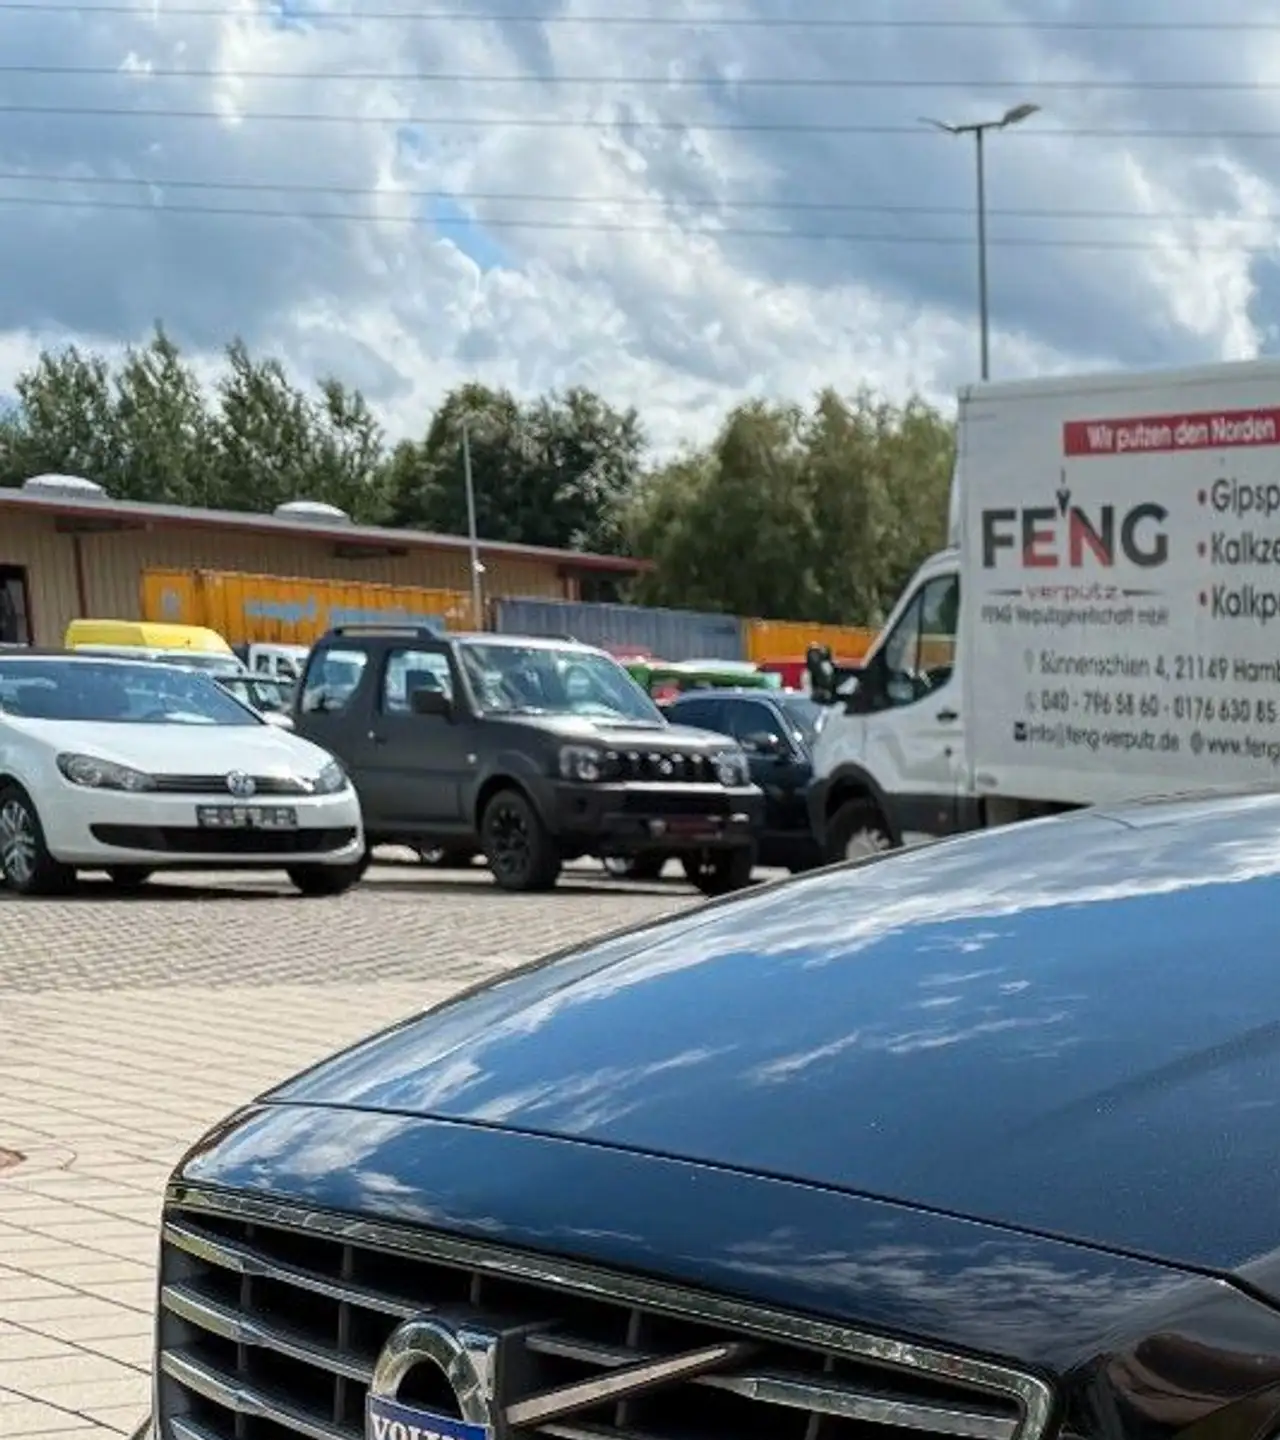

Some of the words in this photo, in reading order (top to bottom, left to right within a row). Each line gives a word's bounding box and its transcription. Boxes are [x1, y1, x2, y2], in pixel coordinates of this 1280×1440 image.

[1087, 425, 1112, 449] Wir
[1116, 422, 1171, 451] putzen
[1174, 418, 1208, 446] den
[1211, 416, 1275, 443] Norden
[981, 502, 1168, 569] FENG
[1174, 654, 1228, 681] 21149
[1174, 695, 1215, 721] 0176
[1218, 698, 1251, 723] 630
